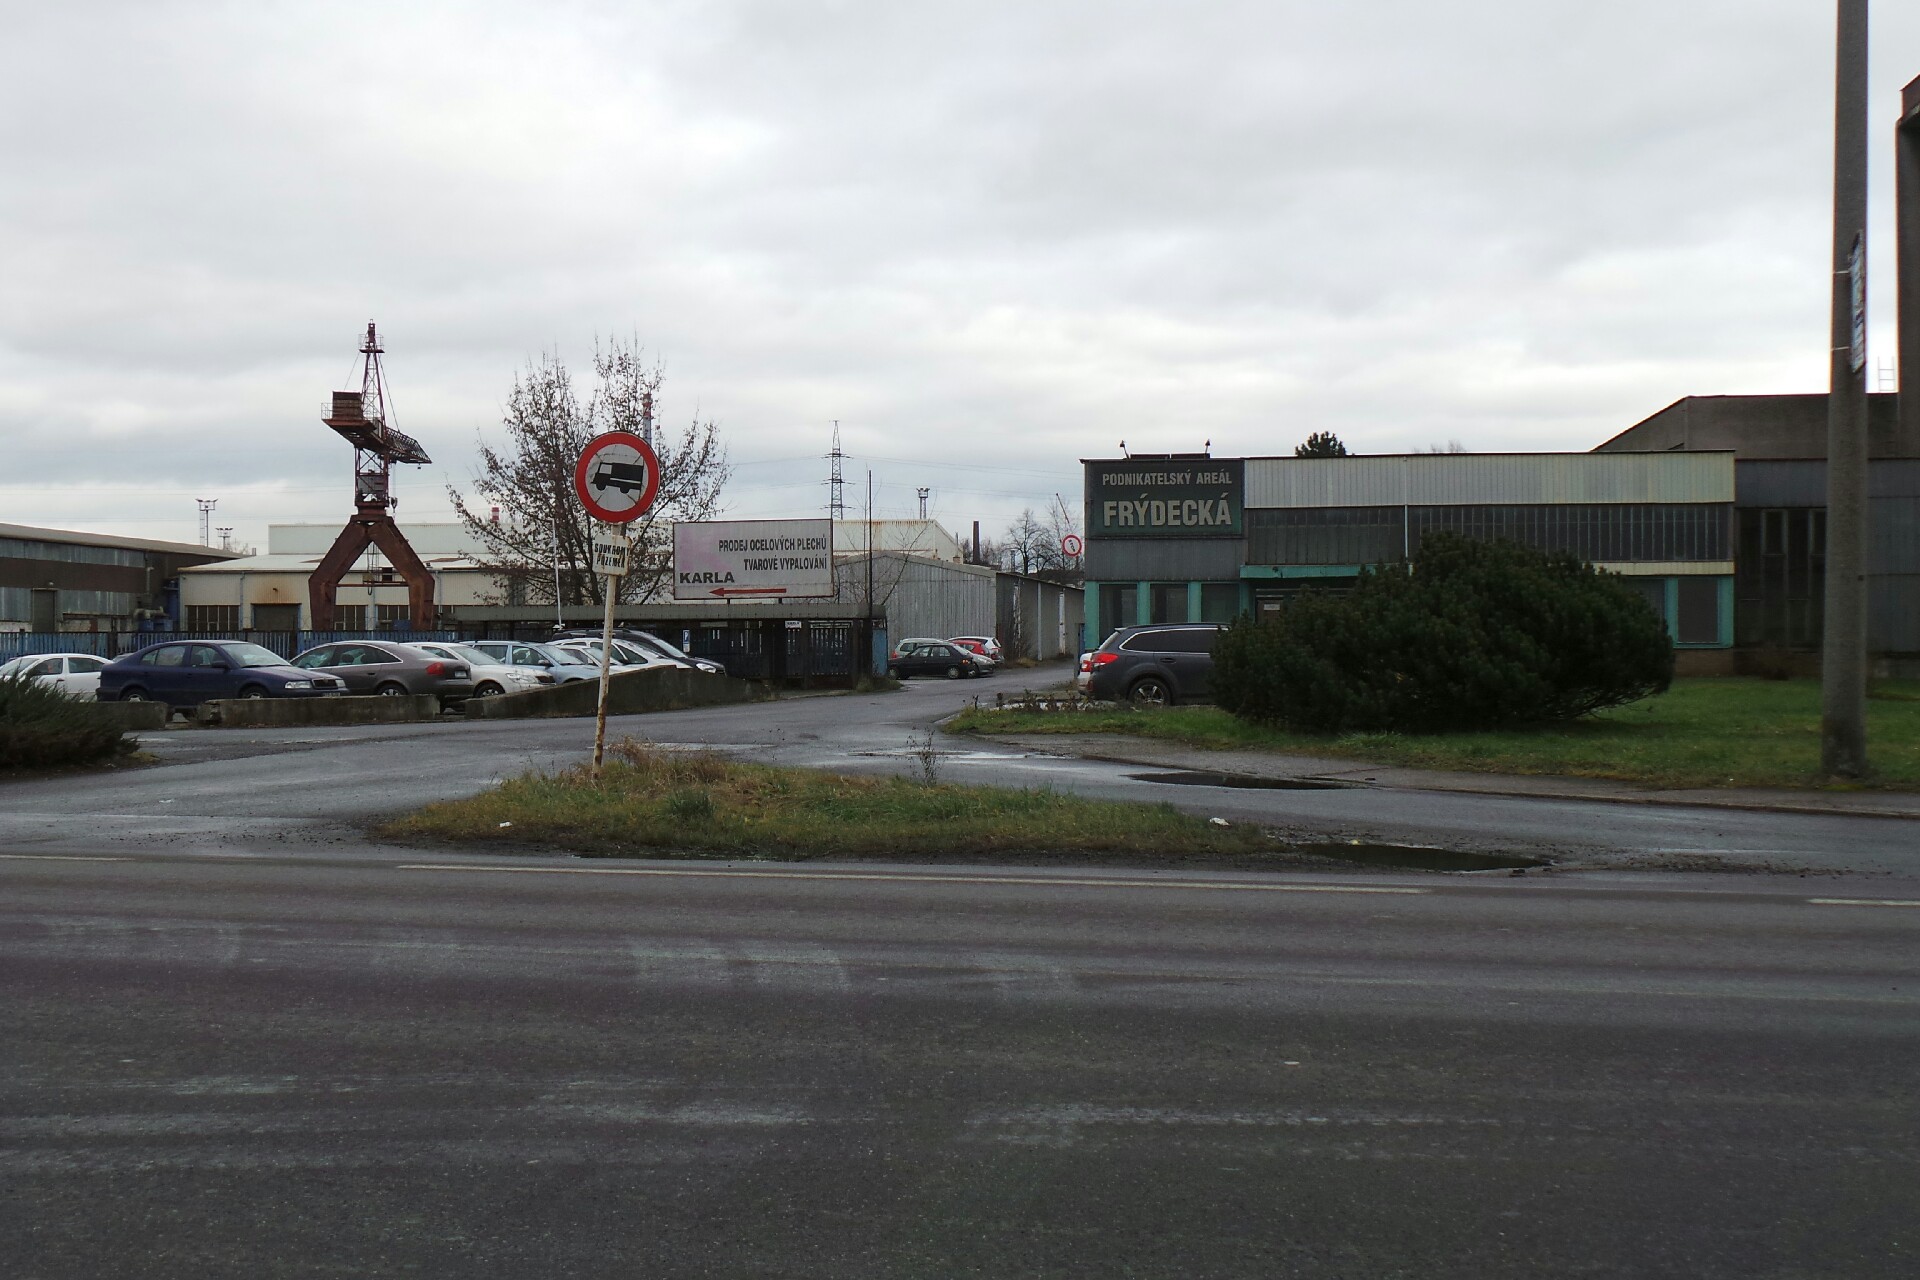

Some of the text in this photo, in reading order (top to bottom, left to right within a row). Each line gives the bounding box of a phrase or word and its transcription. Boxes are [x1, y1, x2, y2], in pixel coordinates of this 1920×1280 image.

[1102, 468, 1233, 486] PODNIKATELSKÝ AREÁL
[1103, 492, 1233, 527] FRÝDECKÁ
[718, 539, 748, 552] PRODEJ
[749, 535, 795, 551] OCELOVÝCH
[743, 553, 828, 571] TVAROVÉ VYPALOVÁNÍ
[679, 571, 735, 584] KARLA
